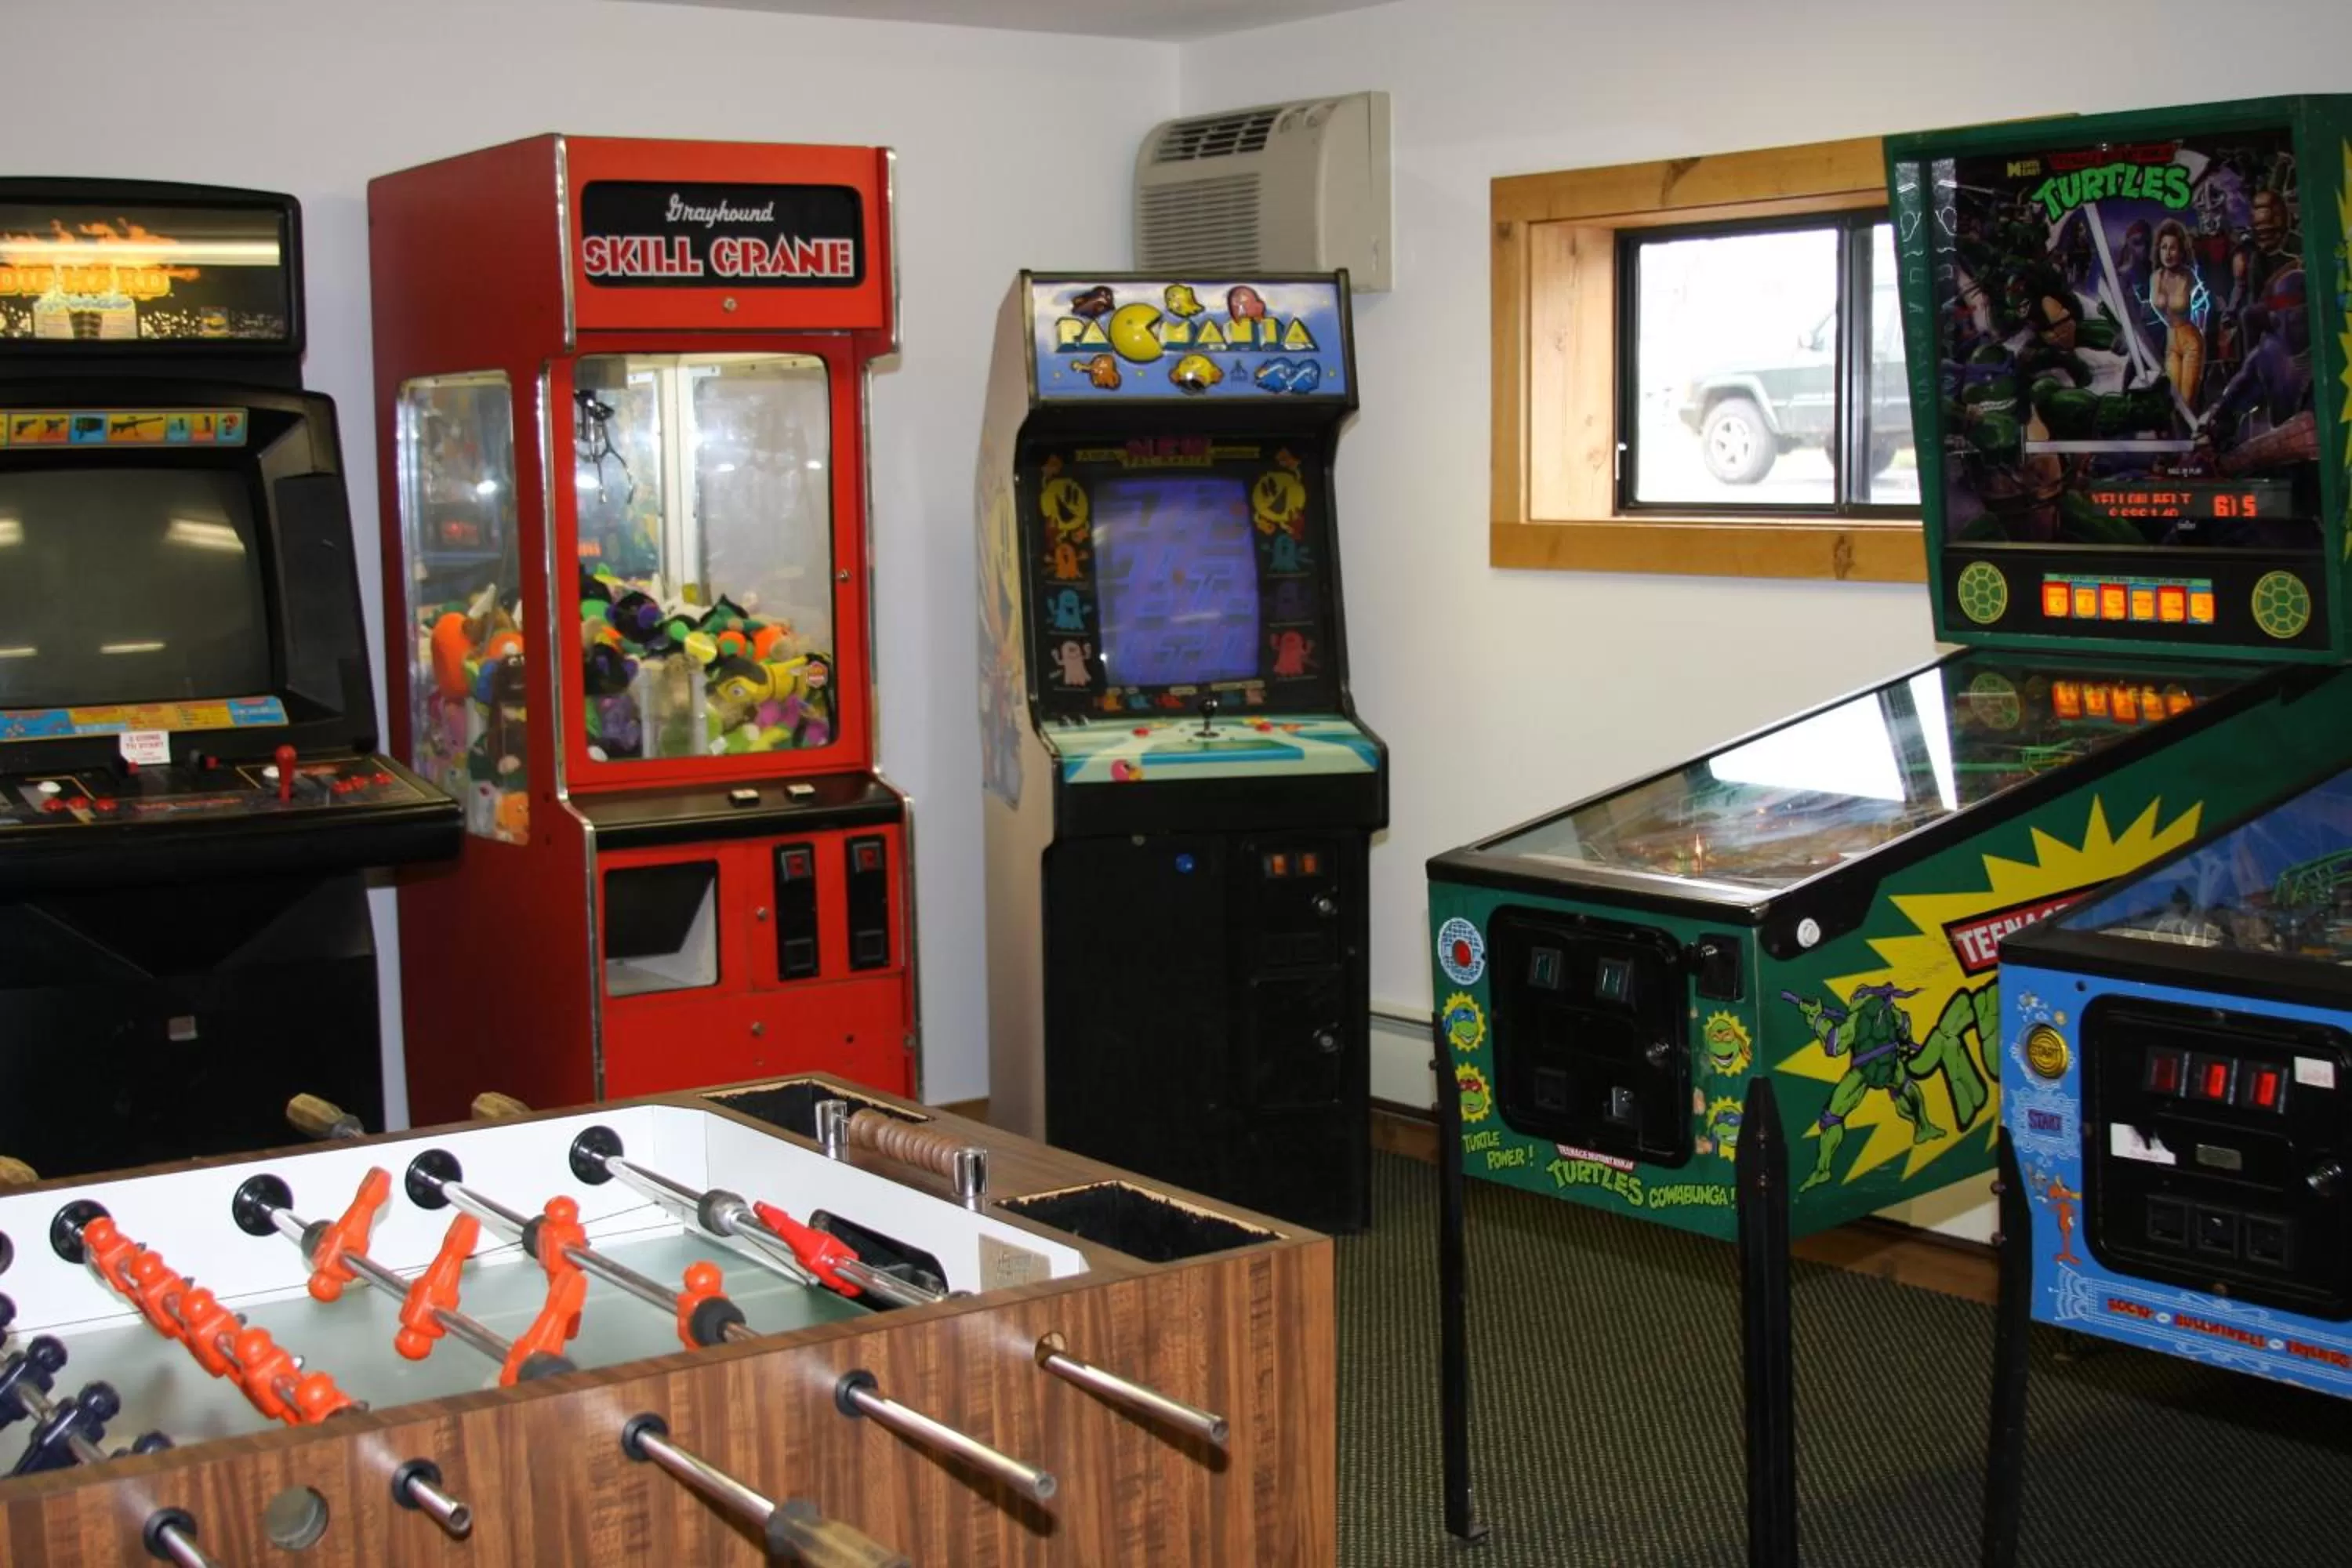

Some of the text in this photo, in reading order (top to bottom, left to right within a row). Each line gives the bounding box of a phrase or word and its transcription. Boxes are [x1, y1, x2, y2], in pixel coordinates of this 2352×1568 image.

[666, 193, 775, 227] Grayhound
[2031, 162, 2191, 220] TURTLES
[583, 233, 855, 277] SKILL CRANE
[1955, 903, 2070, 963] TEEN
[1462, 1131, 1501, 1153] TURTLE
[1546, 1159, 1645, 1207] TURTLES
